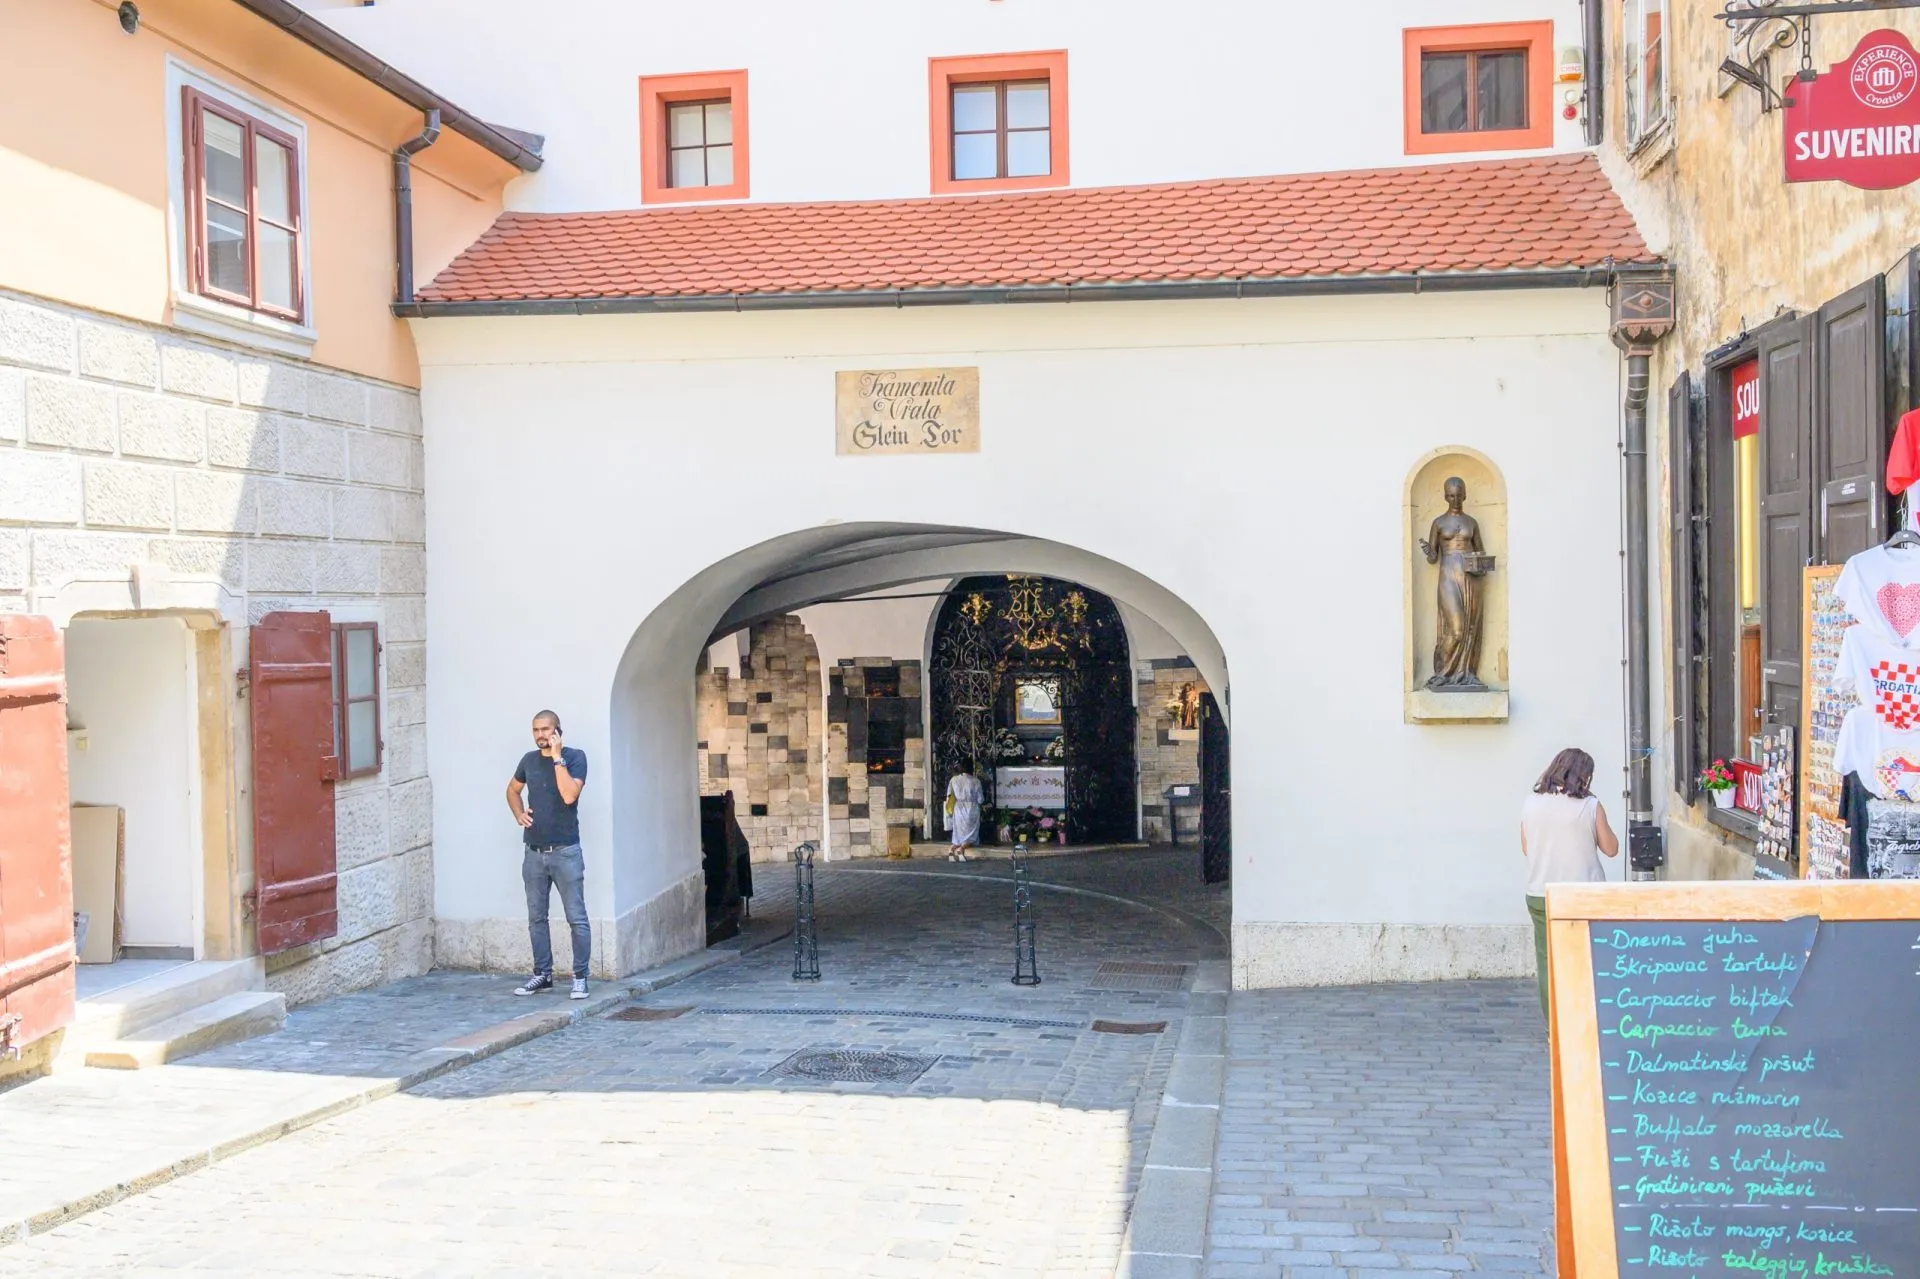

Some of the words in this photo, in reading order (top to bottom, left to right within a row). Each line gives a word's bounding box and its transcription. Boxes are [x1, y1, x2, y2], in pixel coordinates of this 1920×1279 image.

[1854, 48, 1913, 82] EXPERIENCE
[1865, 91, 1904, 105] Croatia
[1736, 377, 1760, 421] SOU
[852, 420, 909, 449] Stein
[919, 419, 962, 448] Tor
[1609, 929, 1686, 951] Dnevna
[1703, 926, 1760, 954] juha
[1611, 954, 1709, 985] Škripavac
[1722, 951, 1797, 980] tartufi
[1616, 987, 1717, 1019] Carpaccio
[1728, 983, 1794, 1016] biftek
[1619, 1014, 1721, 1048] Carpaccio
[1731, 1016, 1788, 1039] tuna
[1626, 1049, 1748, 1074] Dalmatinski
[1760, 1049, 1816, 1083] pršut
[1632, 1078, 1698, 1105] Kozice
[1711, 1086, 1801, 1107] ružmarin
[1633, 1113, 1718, 1144] Buffalo
[1734, 1116, 1844, 1139] mozzarella
[1635, 1145, 1692, 1169] Fuži
[1708, 1155, 1721, 1171] s
[1729, 1148, 1827, 1178] tartufima
[1635, 1173, 1735, 1202] Gratinirani
[1743, 1177, 1816, 1204] puževi
[1649, 1213, 1716, 1239] Rižoto
[1726, 1224, 1792, 1250] mango,
[1796, 1221, 1857, 1245] kozice
[1721, 1248, 1810, 1279] taleggio,
[1813, 1250, 1896, 1277] kruška
